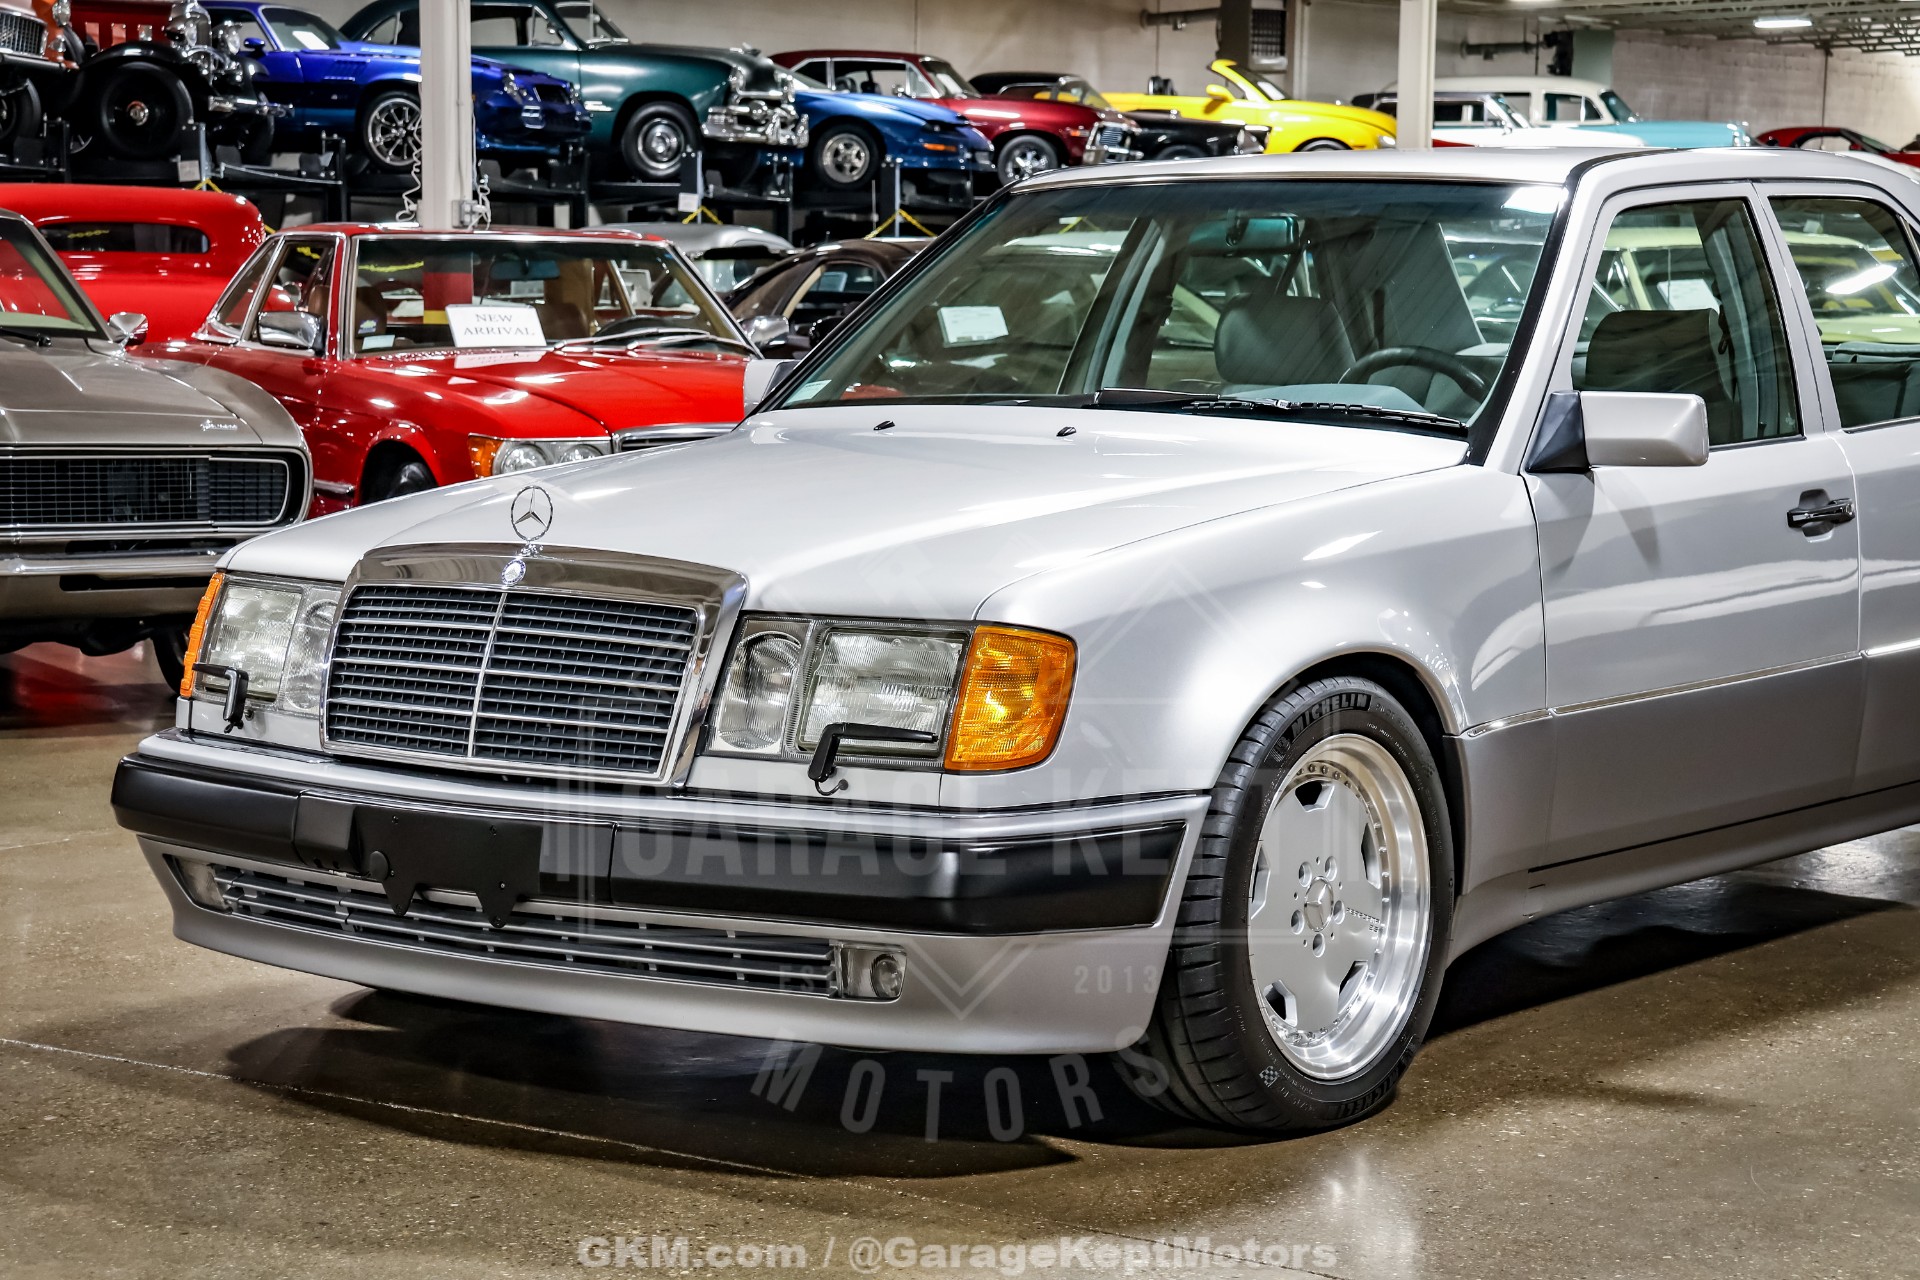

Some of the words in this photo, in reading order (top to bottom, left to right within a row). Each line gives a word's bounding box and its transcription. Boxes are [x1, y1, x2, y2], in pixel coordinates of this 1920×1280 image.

[476, 314, 513, 323] NEW
[463, 326, 536, 336] ARRIVAL
[1291, 694, 1368, 738] MICHELIN
